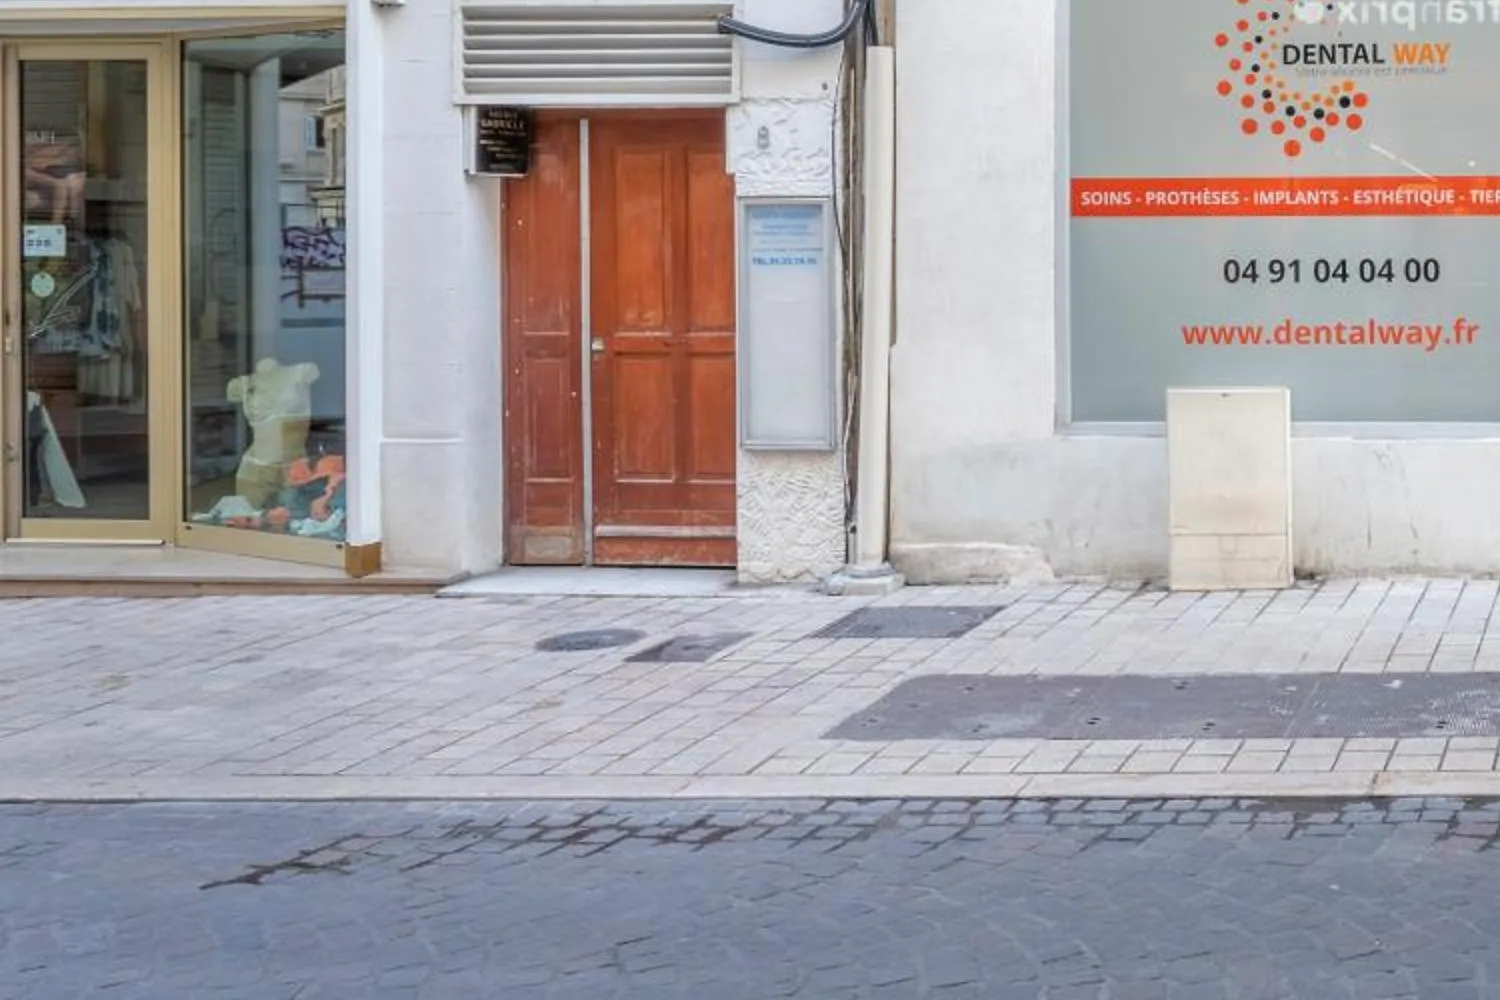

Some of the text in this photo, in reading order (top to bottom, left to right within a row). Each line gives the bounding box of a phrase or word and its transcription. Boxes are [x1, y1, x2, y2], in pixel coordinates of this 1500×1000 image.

[1282, 41, 1451, 66] DENTAL WAY
[1080, 190, 1132, 206] SOINS
[1145, 187, 1240, 206] PROTHÈSES
[1253, 190, 1340, 206] IMPLANTS
[1353, 186, 1455, 207] ESTHÉTIQUE
[1222, 257, 1441, 284] 04 91 04 04 00
[1181, 317, 1480, 352] www.dentalway.fr
